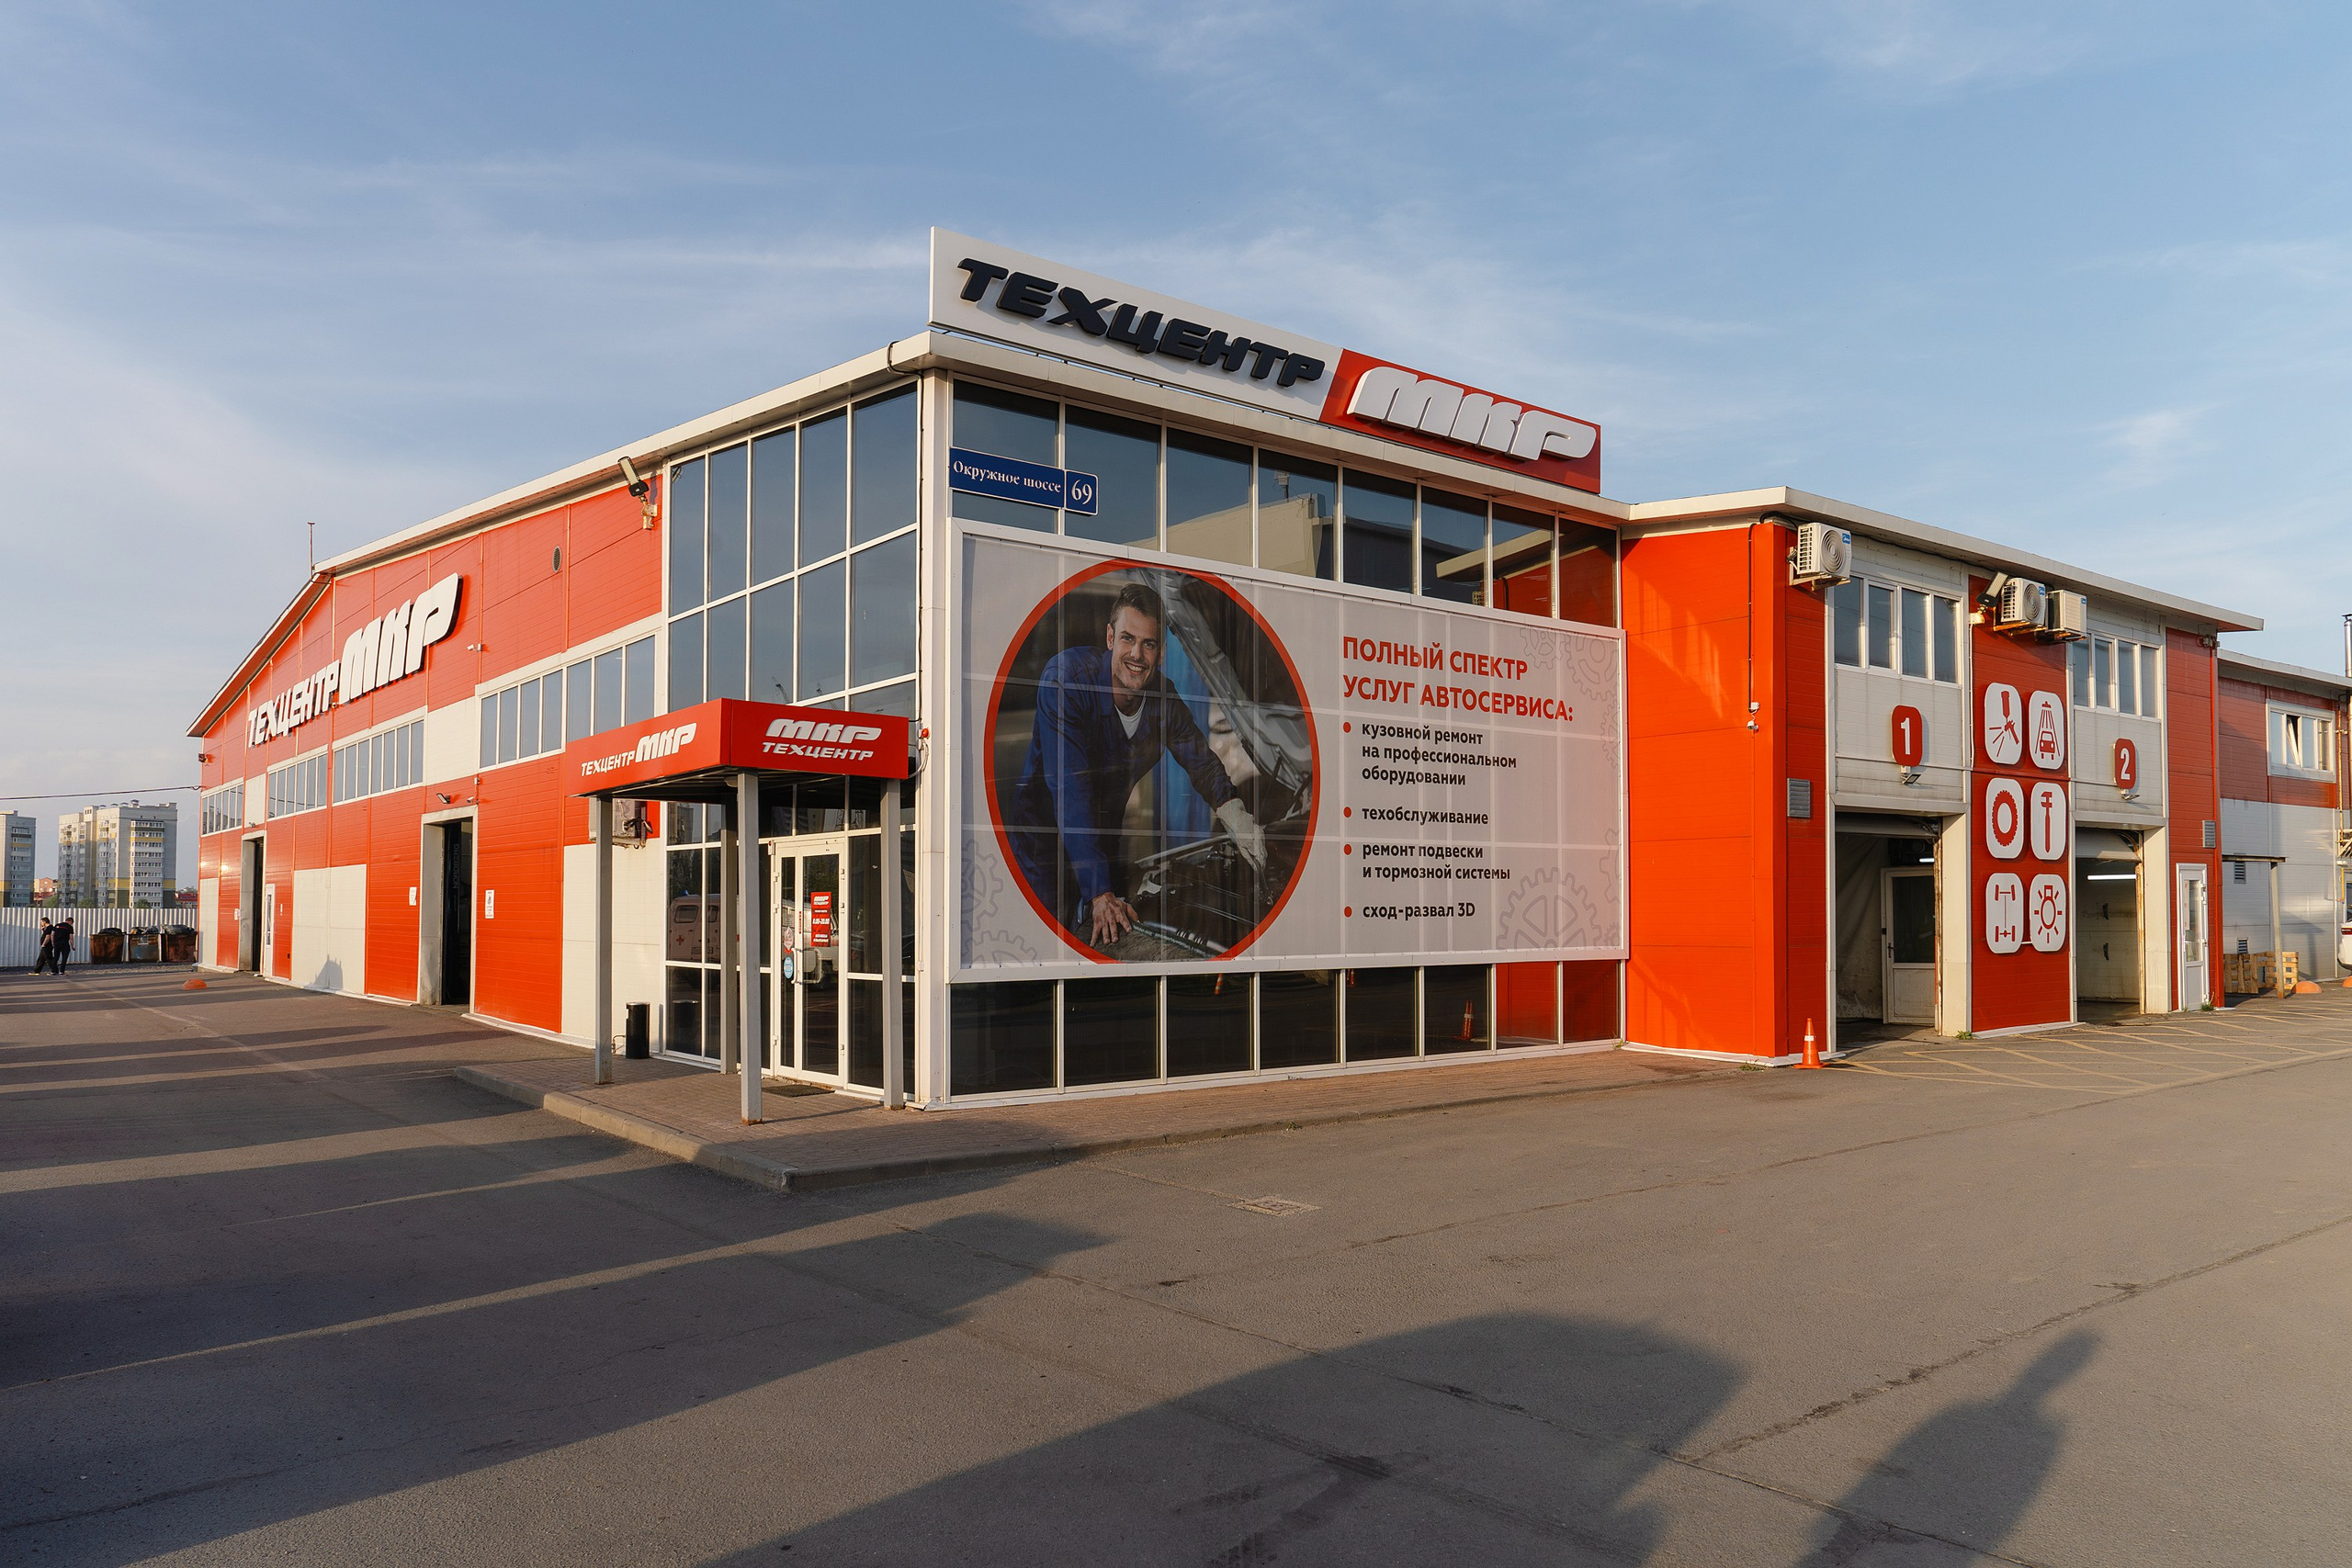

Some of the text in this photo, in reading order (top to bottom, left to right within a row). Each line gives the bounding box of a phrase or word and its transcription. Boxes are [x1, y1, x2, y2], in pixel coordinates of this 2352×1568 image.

[957, 257, 1597, 461] ТЕХЦЕНТР МКР
[953, 460, 1093, 505] Окружное шоссе 69
[248, 572, 460, 749] ТЕХЦЕНТР МКР
[1342, 636, 1529, 681] ПОЛНЫЙ СПЕКТР
[1342, 674, 1574, 722] УСЛУГ АВТОСЕРВИСА:
[765, 718, 883, 744] МКР
[1362, 723, 1484, 745] кузовной ремонт
[1900, 717, 1911, 755] 1
[581, 722, 698, 777] ТЕХЦЕНТР МКР
[762, 741, 874, 761] ТЕХЦЕНТР
[1362, 745, 1517, 769] на профессиональном
[1362, 765, 1466, 786] оборудовании
[2120, 748, 2132, 780] 2
[1362, 807, 1489, 826] техобслуживание
[1363, 843, 1484, 860] ремонт подвески
[1363, 863, 1511, 882] и тормозной системы
[1363, 902, 1476, 921] сход-развал 3D
